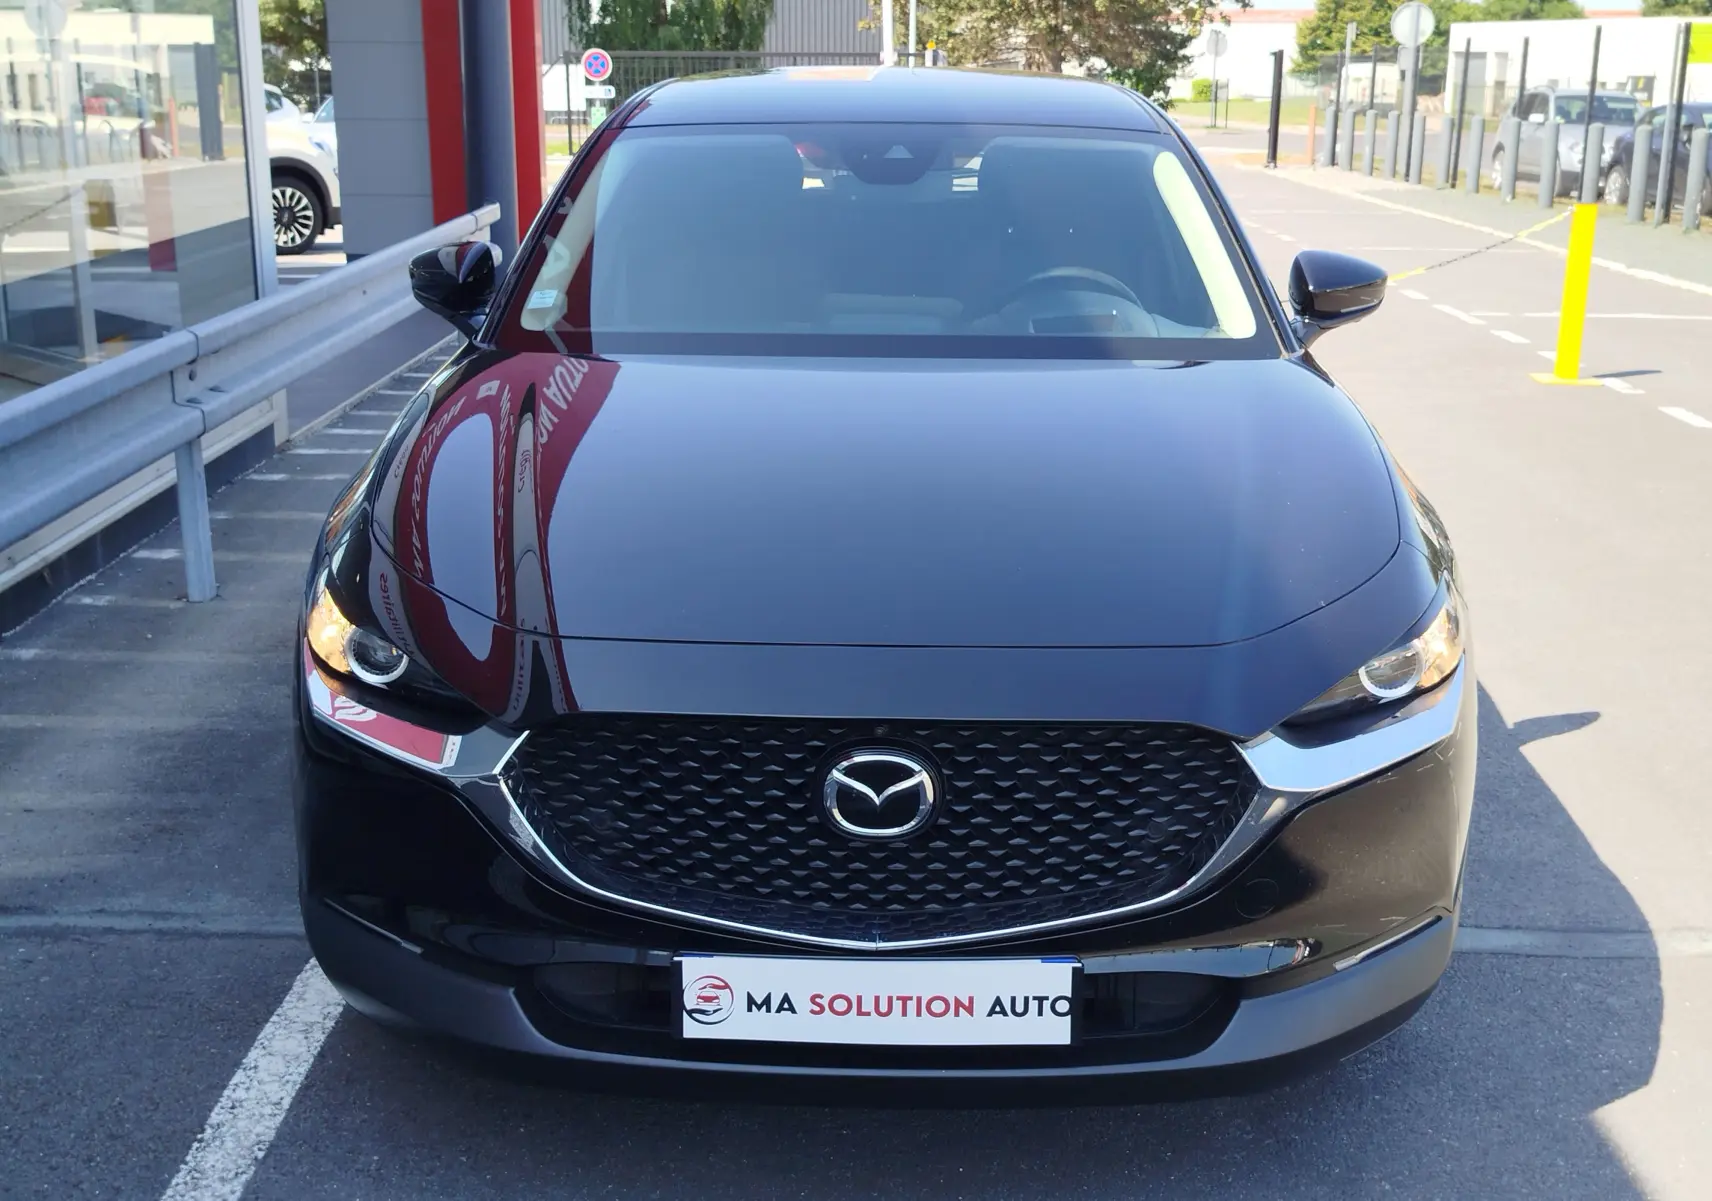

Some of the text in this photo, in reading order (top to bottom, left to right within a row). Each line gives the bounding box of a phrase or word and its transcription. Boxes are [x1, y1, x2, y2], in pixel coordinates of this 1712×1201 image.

[746, 990, 1073, 1018] MA SOLUTION AUTO
